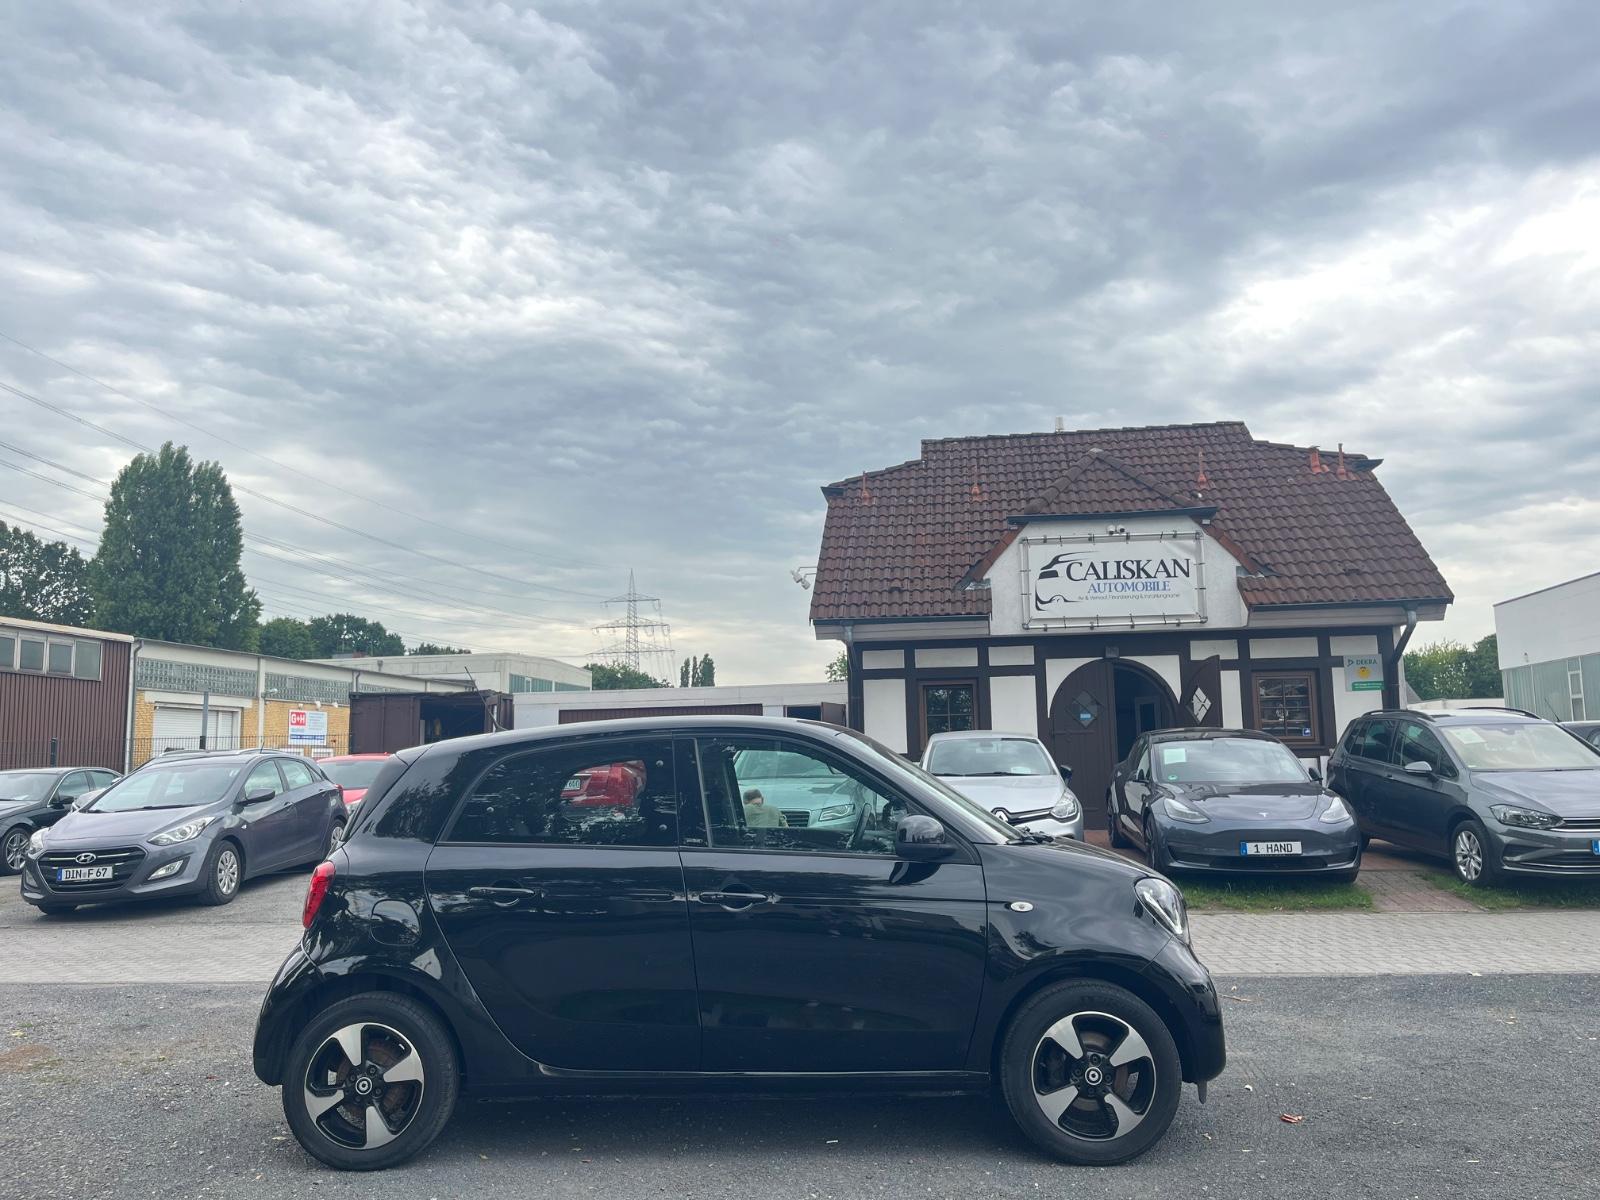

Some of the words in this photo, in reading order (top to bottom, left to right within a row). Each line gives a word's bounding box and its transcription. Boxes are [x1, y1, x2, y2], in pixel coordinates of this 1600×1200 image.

[1066, 559, 1190, 581] CALISKAN
[1088, 581, 1171, 593] AUTOMOBILE
[1254, 843, 1260, 853] 1
[1266, 843, 1293, 853] HAND
[65, 869, 82, 879] DIN
[88, 868, 94, 878] F
[96, 867, 107, 877] 67
